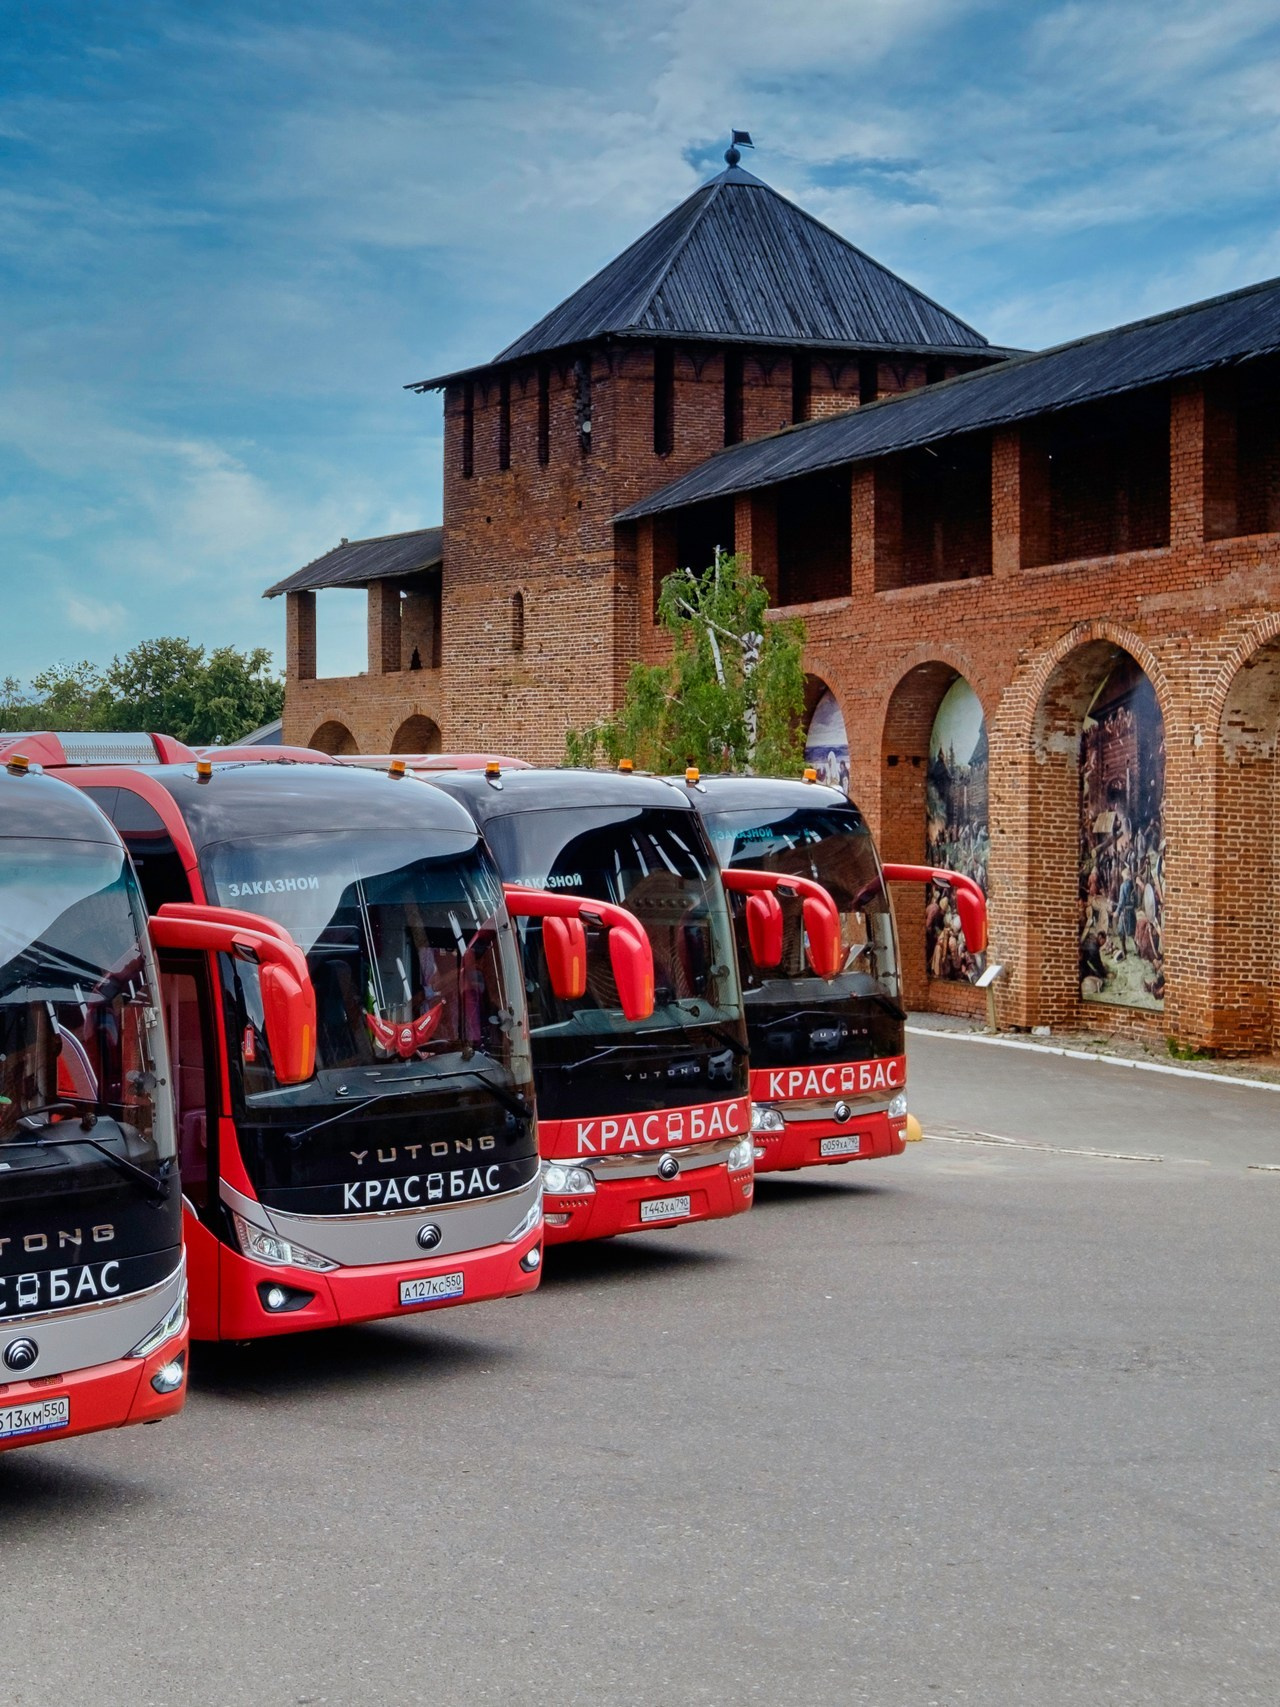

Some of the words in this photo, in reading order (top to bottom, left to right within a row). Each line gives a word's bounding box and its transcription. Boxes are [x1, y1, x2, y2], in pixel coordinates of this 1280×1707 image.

[228, 875, 320, 897] ЗАКАЗНОЙ
[809, 1028, 868, 1038] YUTONG
[625, 1066, 701, 1081] YUTONG
[769, 1068, 836, 1098] КРАС
[860, 1061, 897, 1089] БАС
[577, 1115, 660, 1153] КРАС
[690, 1103, 739, 1139] БАС
[350, 1135, 495, 1165] YUTONG
[344, 1176, 420, 1210] КРАС
[450, 1165, 500, 1197] БАС
[50, 1261, 120, 1302] БАС
